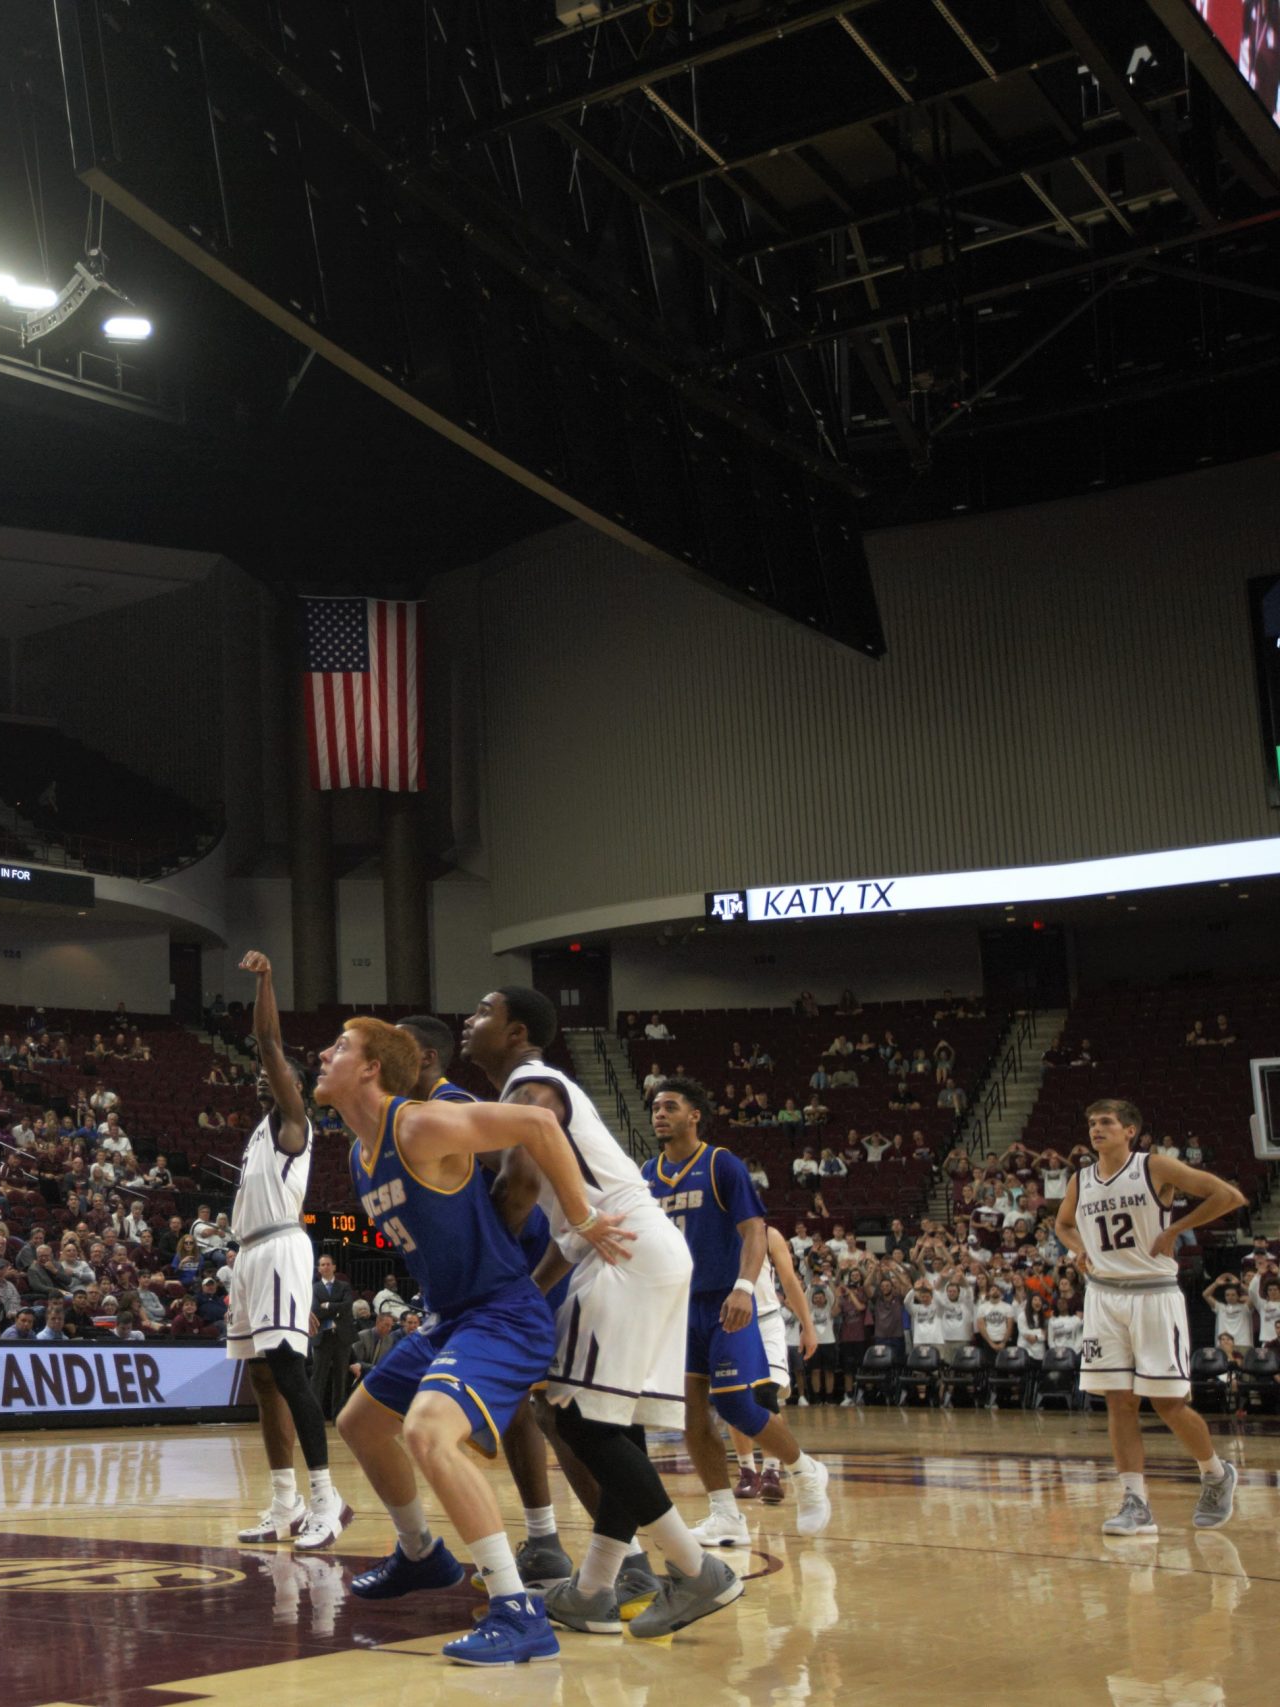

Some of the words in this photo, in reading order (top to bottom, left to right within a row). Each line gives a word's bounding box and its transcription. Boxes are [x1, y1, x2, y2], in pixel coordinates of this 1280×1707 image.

[1, 867, 10, 878] IN
[12, 869, 31, 881] FOR
[764, 885, 845, 916] KATY,
[857, 881, 896, 909] TX
[659, 1190, 704, 1214] CSB
[1081, 1198, 1117, 1217] TEXAS
[1120, 1193, 1147, 1209] A&M
[332, 1215, 356, 1232] 1:00
[1094, 1212, 1136, 1252] 12
